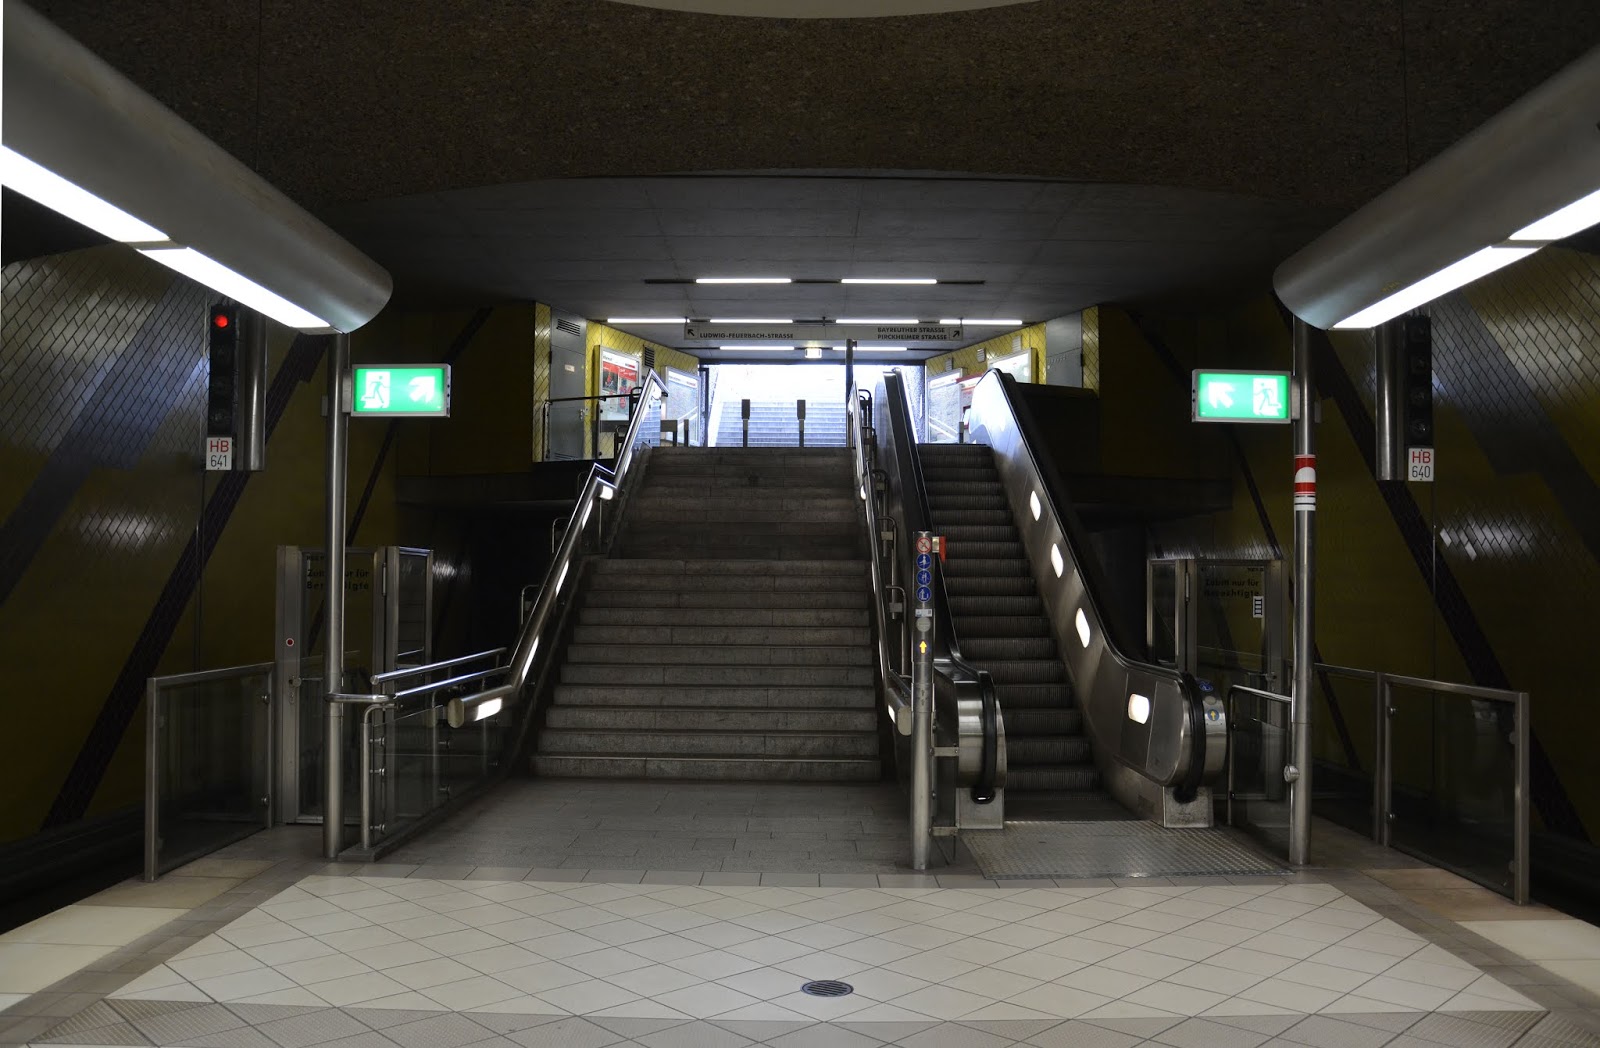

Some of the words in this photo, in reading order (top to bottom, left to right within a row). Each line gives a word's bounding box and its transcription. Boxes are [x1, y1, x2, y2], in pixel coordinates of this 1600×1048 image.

[210, 440, 229, 452] HB
[210, 455, 227, 468] 641
[1412, 451, 1431, 463] HB
[1412, 465, 1431, 478] 640
